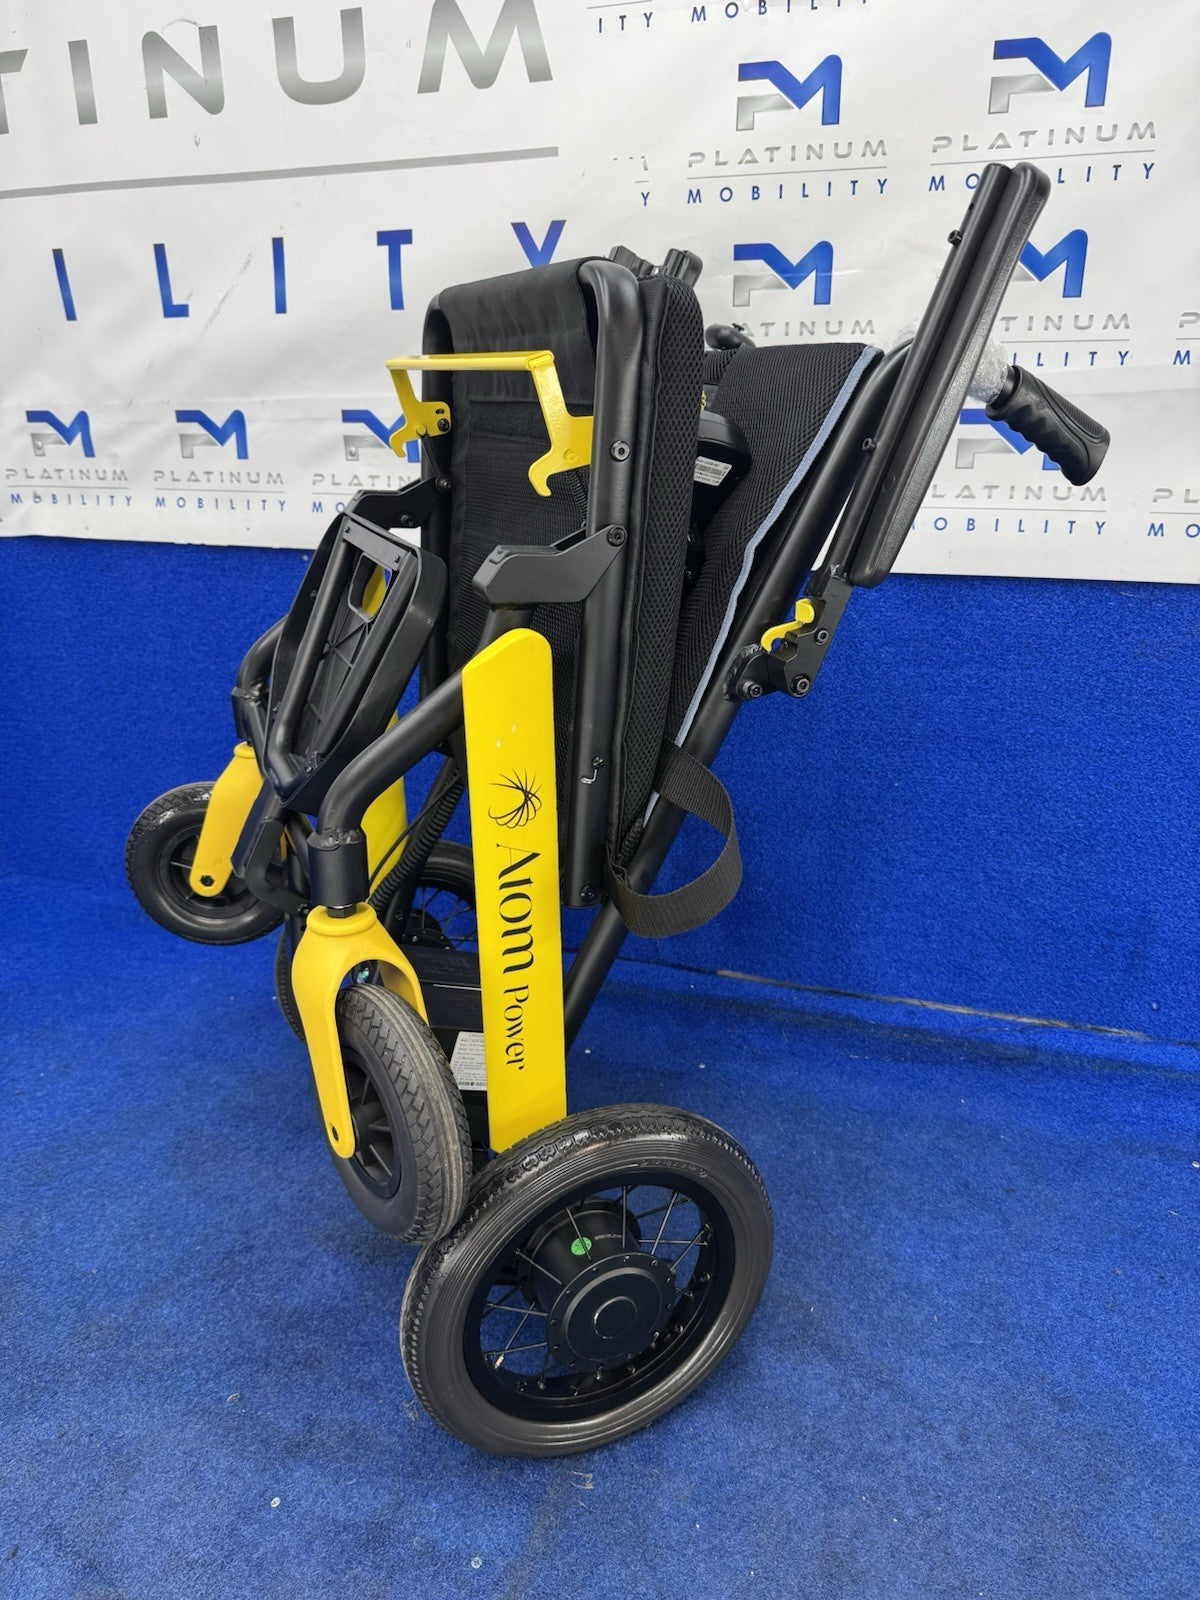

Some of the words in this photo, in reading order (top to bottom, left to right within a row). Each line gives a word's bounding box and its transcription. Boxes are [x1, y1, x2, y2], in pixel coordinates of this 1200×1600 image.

[691, 0, 867, 23] MOBIL
[932, 121, 1156, 154] PLATINUM
[687, 139, 888, 168] PLATINUM
[928, 162, 1155, 192] MOLITY
[687, 178, 888, 205] MOBILITY
[5, 467, 129, 483] PLATINUM
[154, 469, 285, 485] PLATINUM
[10, 493, 132, 506] MOBILITY
[155, 497, 286, 512] MOBILITY
[911, 516, 1107, 536] OBILITY
[496, 843, 541, 974] Atom
[503, 985, 529, 1071] Power
